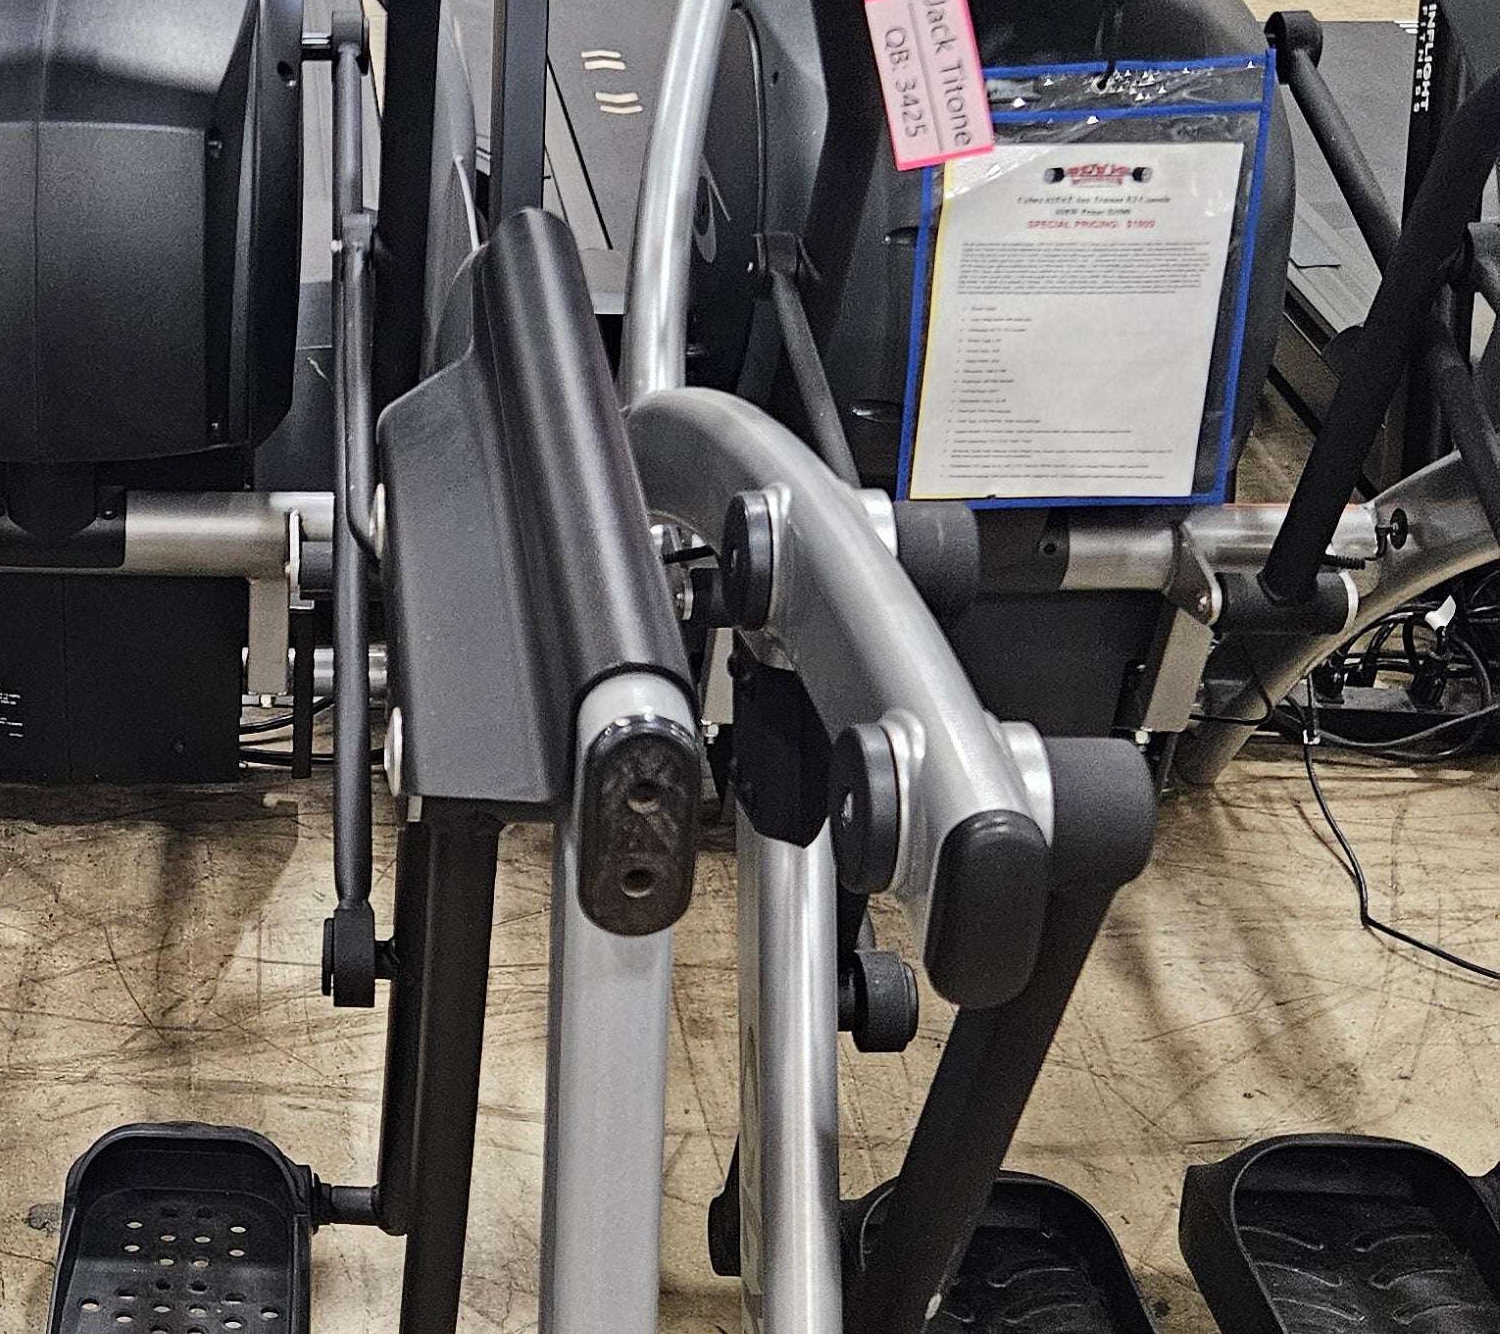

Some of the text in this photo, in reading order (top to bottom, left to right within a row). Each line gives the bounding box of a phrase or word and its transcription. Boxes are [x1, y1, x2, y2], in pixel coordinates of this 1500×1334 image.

[1420, 3, 1437, 112] INFLIGHT
[895, 78, 928, 139] 3425
[940, 59, 973, 148] Titone
